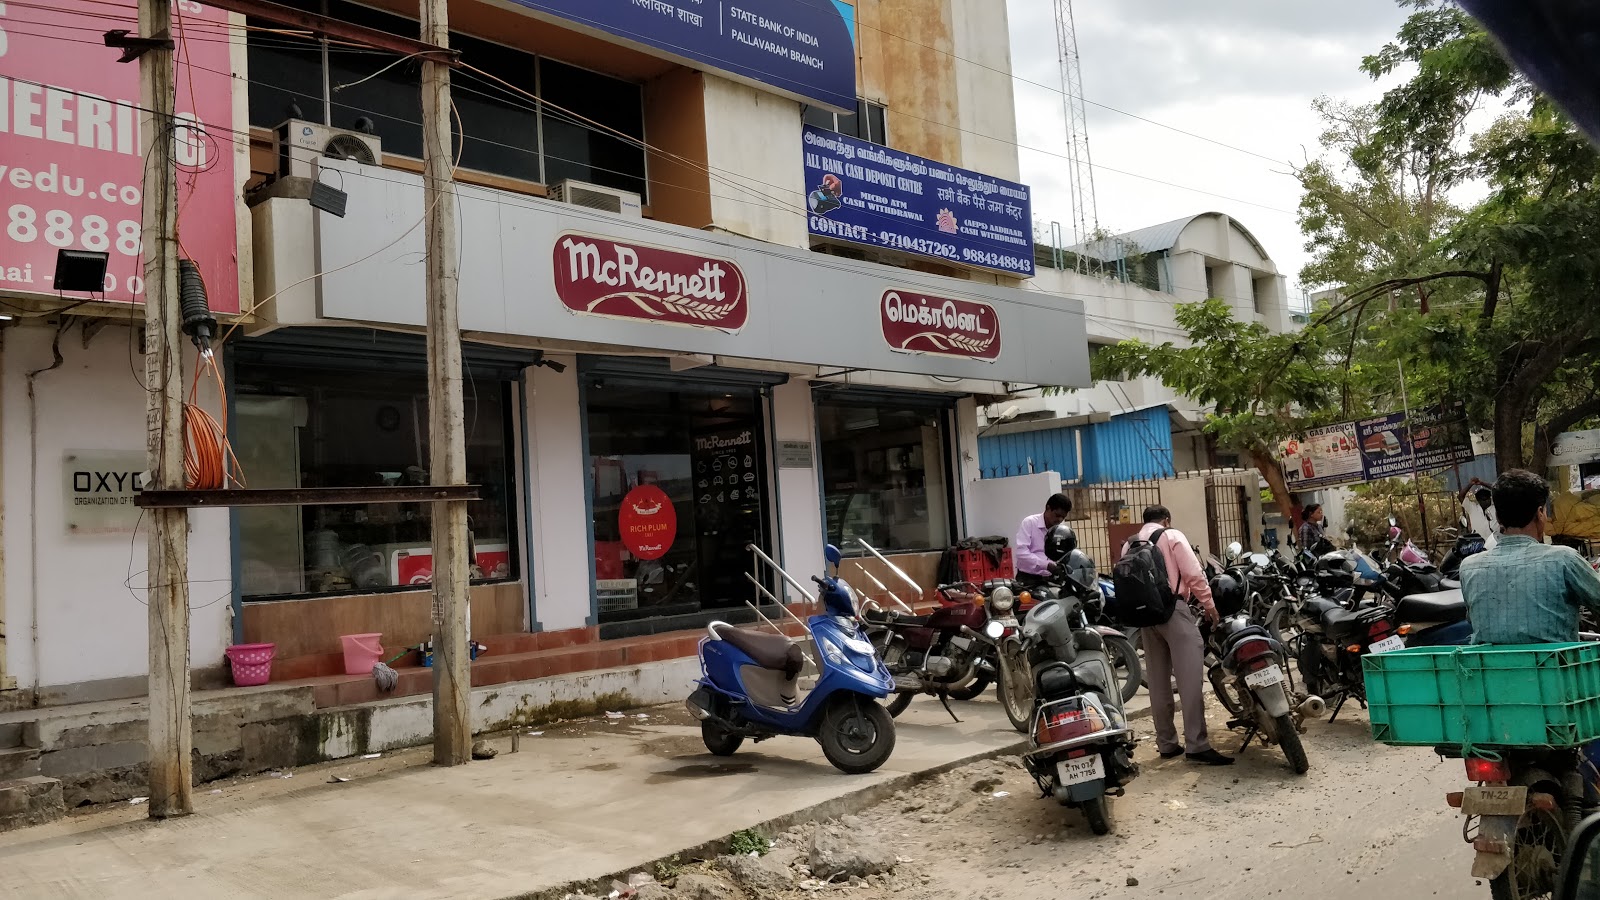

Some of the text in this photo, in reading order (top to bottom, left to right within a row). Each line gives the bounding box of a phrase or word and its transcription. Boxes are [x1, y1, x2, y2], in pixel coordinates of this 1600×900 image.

[676, 8, 704, 28] शाखा
[730, 6, 819, 48] STATE BANK OF INDIA
[731, 29, 824, 71] PALLAVARAM BRANCH
[0, 76, 207, 169] EERIG
[804, 131, 1028, 201] அனைத்து வங்கிகளுக்கும் பணம் செலுத்தும் மையம்
[806, 152, 924, 196] ALL BANK CASH DEPOSIT CENTRE
[842, 196, 925, 222] CASH WITHDRAWAL
[860, 191, 908, 210] MICRO ATM
[937, 187, 956, 203] सभी
[972, 192, 986, 211] पैसे
[986, 199, 1005, 215] जमा
[960, 226, 1028, 247] CASH WITHDRAWAL
[963, 218, 1023, 238] (AEPS) AADHAAR
[810, 215, 869, 241] CONTACT
[880, 230, 961, 261] 9710437262,
[962, 247, 1032, 272] 9884348843
[562, 237, 727, 302] McRennett
[695, 430, 752, 451] McRennett
[1309, 428, 1324, 438] GAS
[1325, 423, 1355, 435] AGENCY
[1369, 466, 1383, 475] SHRI
[1383, 457, 1425, 472] RENGANATAN
[1425, 453, 1447, 466] PARCEL
[74, 496, 119, 506] ORGANIZATION
[120, 496, 128, 505] OF
[630, 523, 668, 533] RICH PLUM
[1262, 669, 1271, 677] 22
[1051, 710, 1083, 726] ARMY
[1071, 764, 1080, 772] TN
[1080, 768, 1097, 778] 7758
[1481, 790, 1509, 800] TN-22
